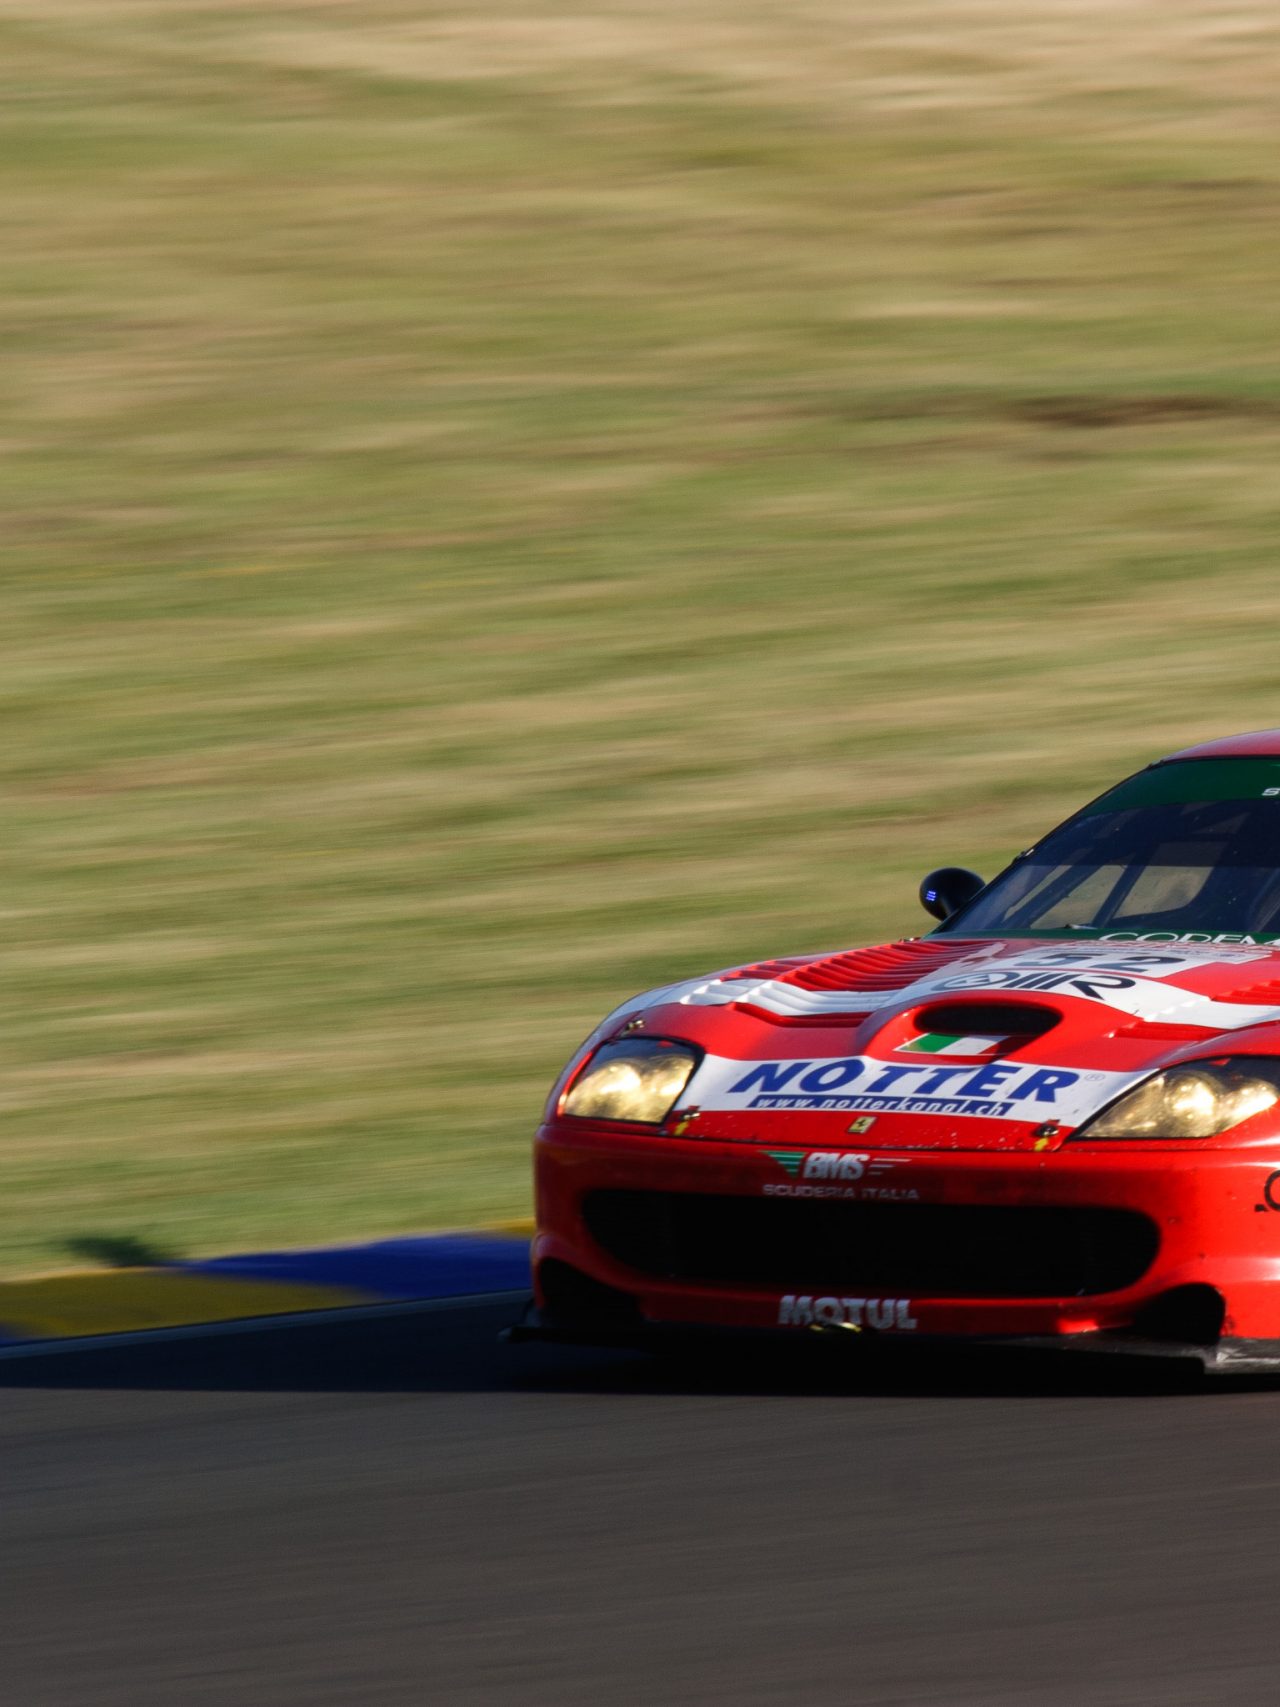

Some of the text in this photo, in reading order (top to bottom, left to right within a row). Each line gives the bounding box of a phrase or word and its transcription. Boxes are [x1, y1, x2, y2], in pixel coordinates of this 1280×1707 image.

[1013, 952, 1187, 973] 52
[726, 1058, 1081, 1103] NOTTER
[755, 1095, 1004, 1117] www.notterkanal.ch
[803, 1152, 869, 1180] BMS
[762, 1183, 920, 1200] SCUDERIA ITALIA
[777, 1294, 918, 1330] MOTUL
